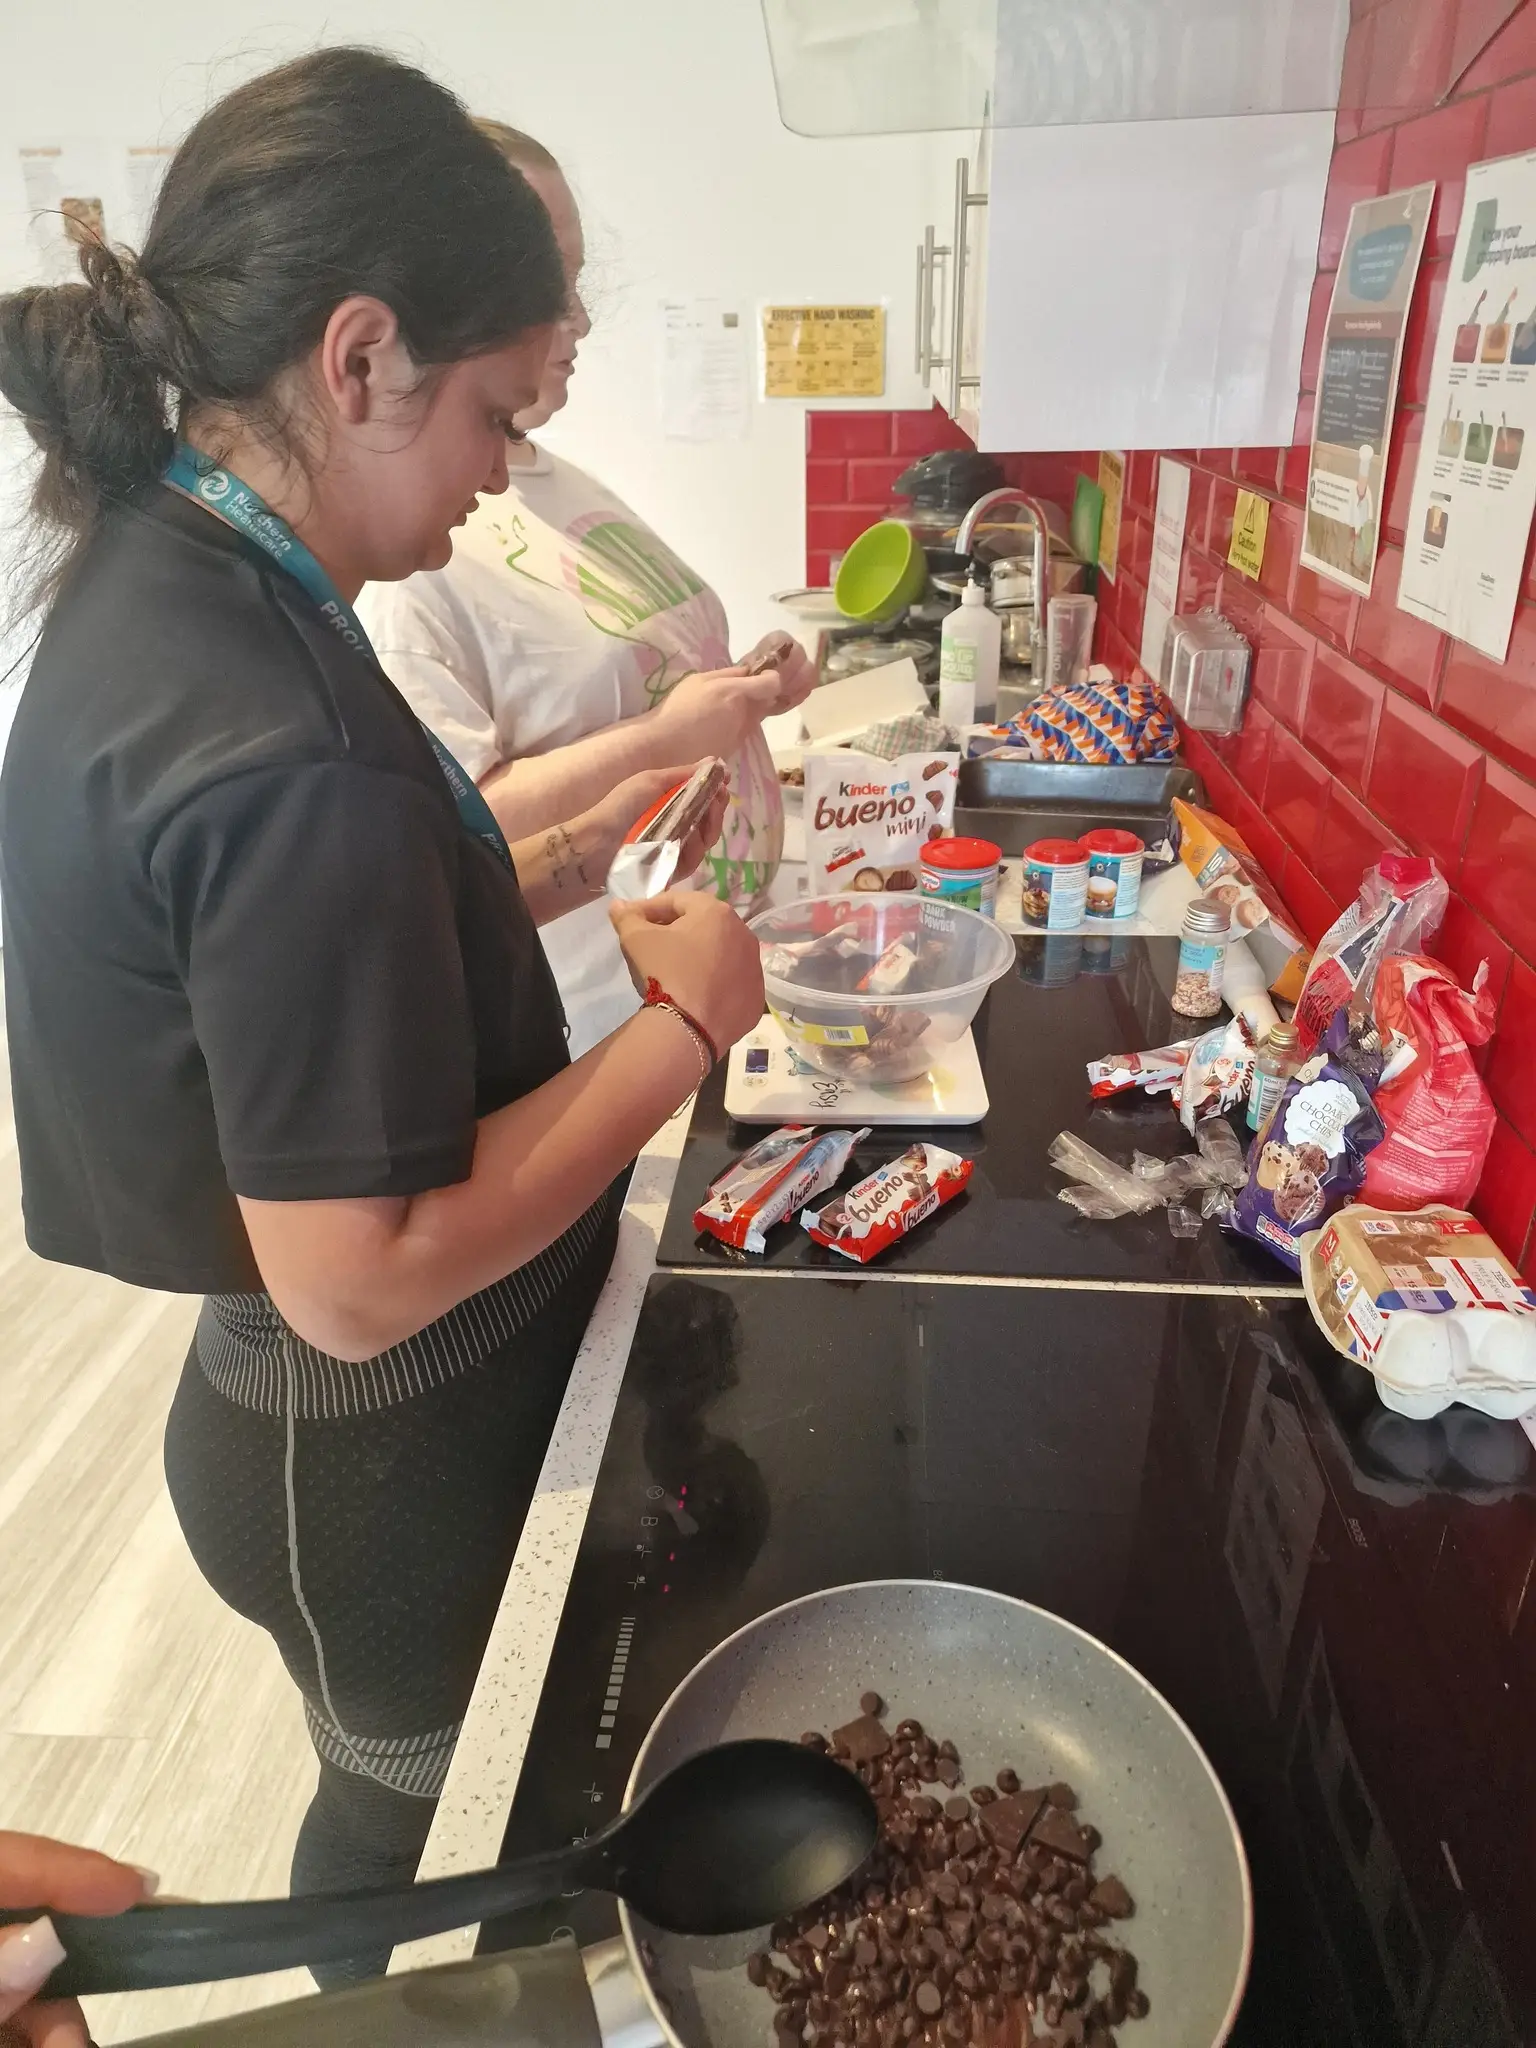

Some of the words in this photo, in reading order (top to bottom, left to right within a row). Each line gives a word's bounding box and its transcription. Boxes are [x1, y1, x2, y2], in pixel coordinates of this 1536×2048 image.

[1237, 531, 1257, 553] Caution
[814, 795, 916, 831] bueno
[886, 811, 927, 837] mini
[849, 1174, 904, 1223] bueno
[907, 1193, 936, 1229] bueno
[1495, 1270, 1512, 1289] TESCO
